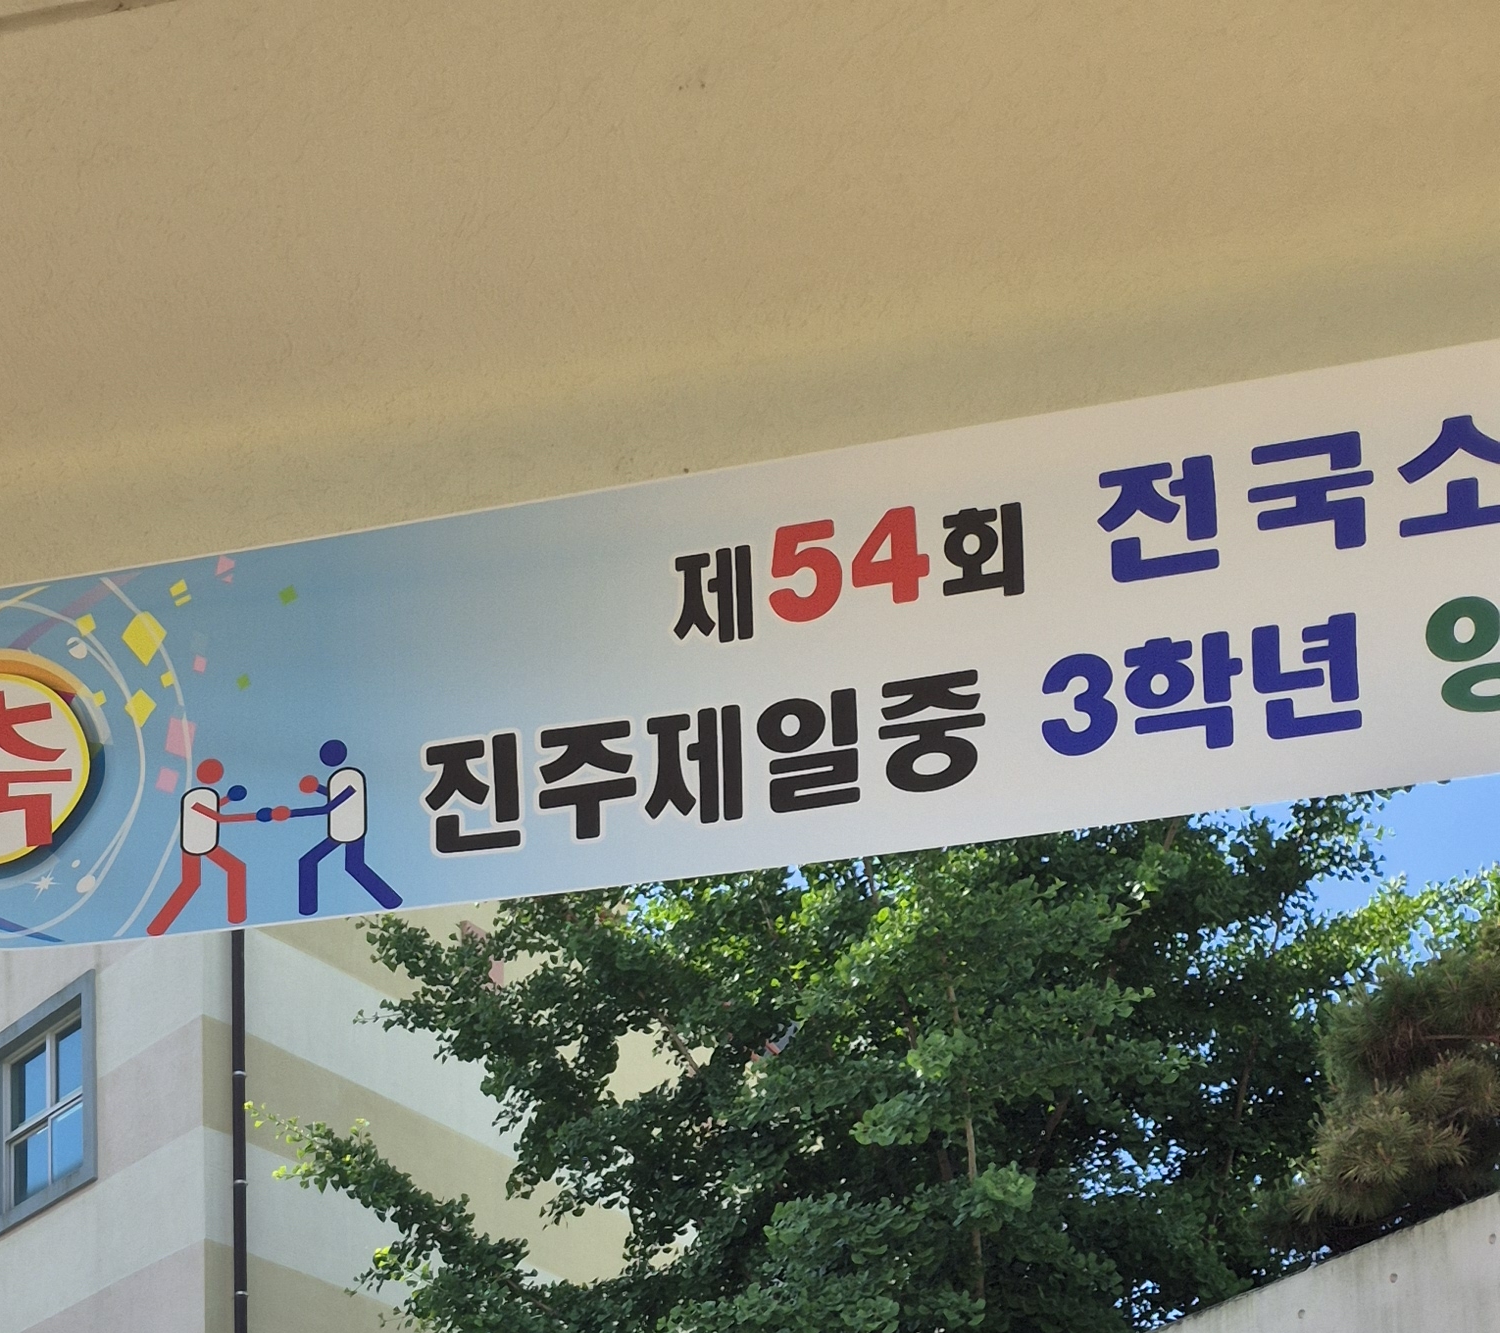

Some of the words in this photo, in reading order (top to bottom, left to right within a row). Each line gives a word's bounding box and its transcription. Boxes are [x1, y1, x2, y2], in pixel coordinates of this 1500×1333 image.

[673, 502, 1026, 645] 제54회
[1097, 414, 1500, 583] 전국소
[424, 670, 986, 853] 진주제일중
[1041, 613, 1363, 757] 3학년
